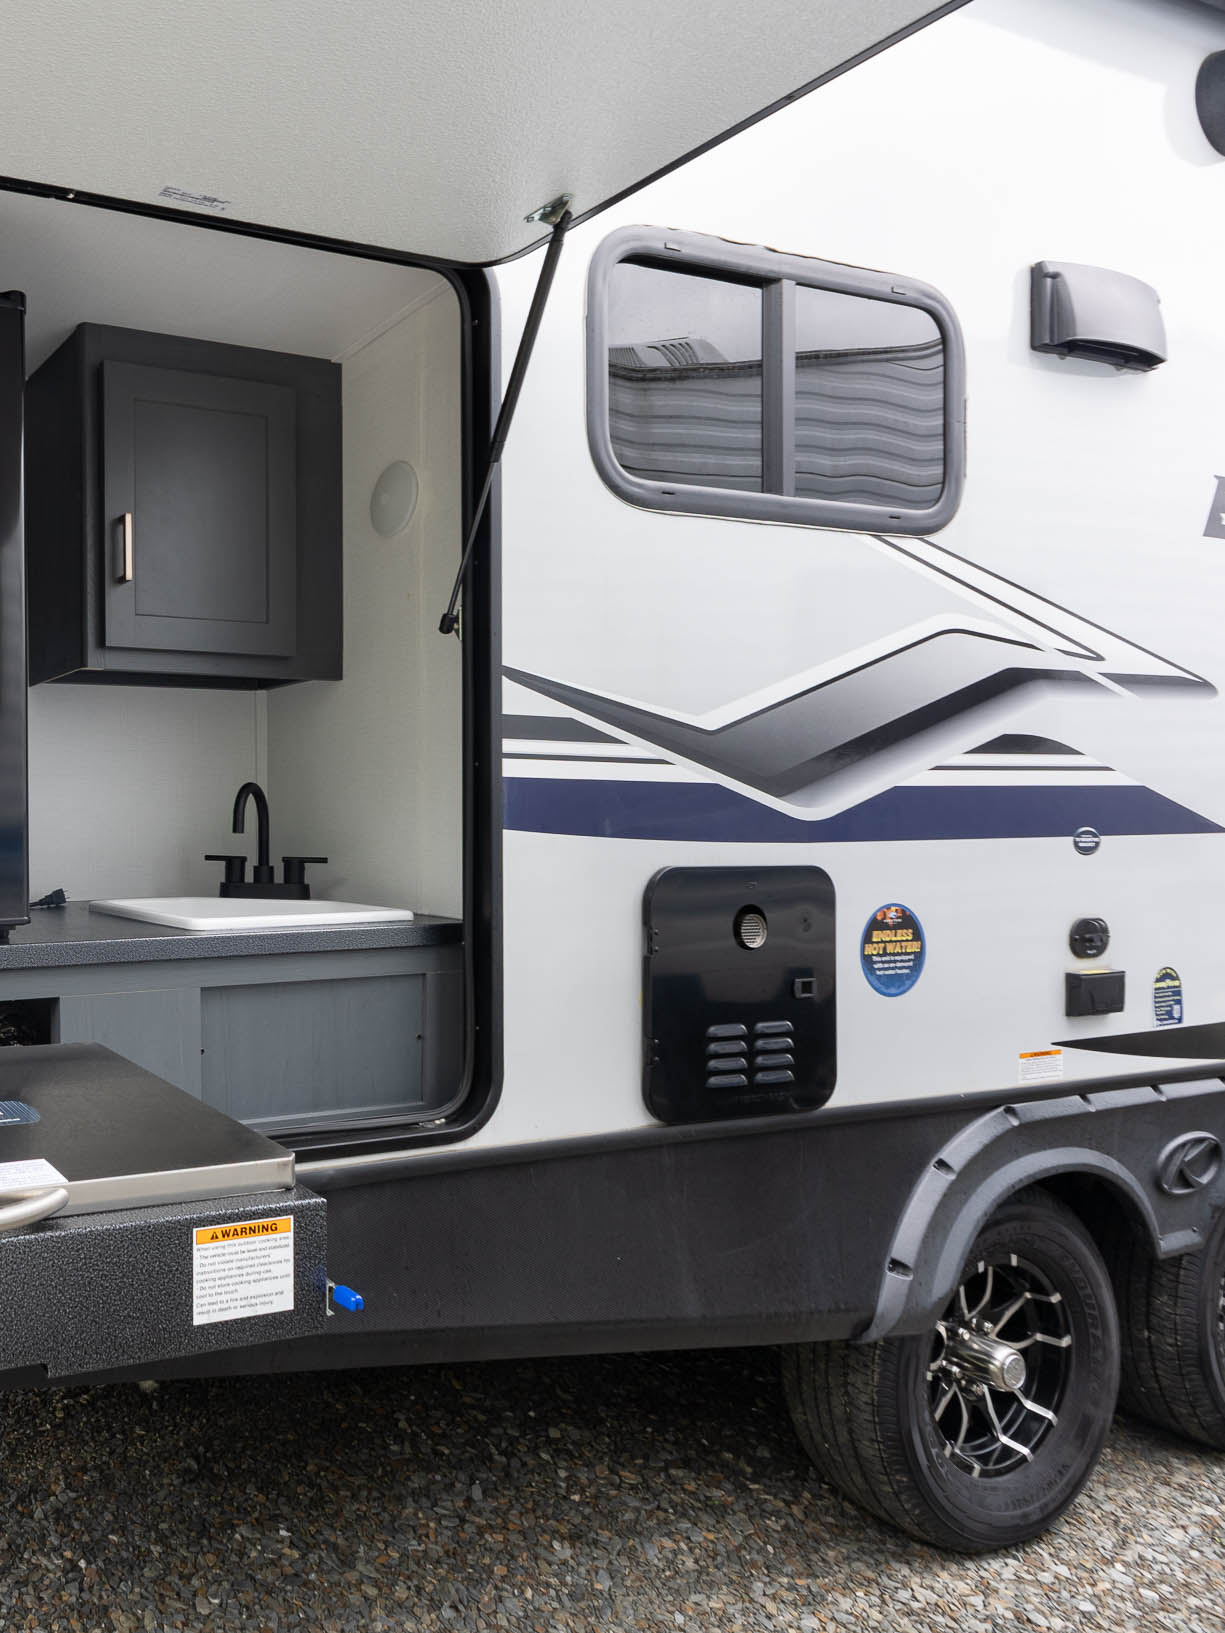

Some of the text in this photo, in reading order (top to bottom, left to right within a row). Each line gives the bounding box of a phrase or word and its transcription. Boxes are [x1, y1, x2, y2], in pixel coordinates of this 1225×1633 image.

[871, 928, 913, 942] ENDLESS
[864, 943, 885, 955] HOT
[221, 1223, 278, 1239] WARNING
